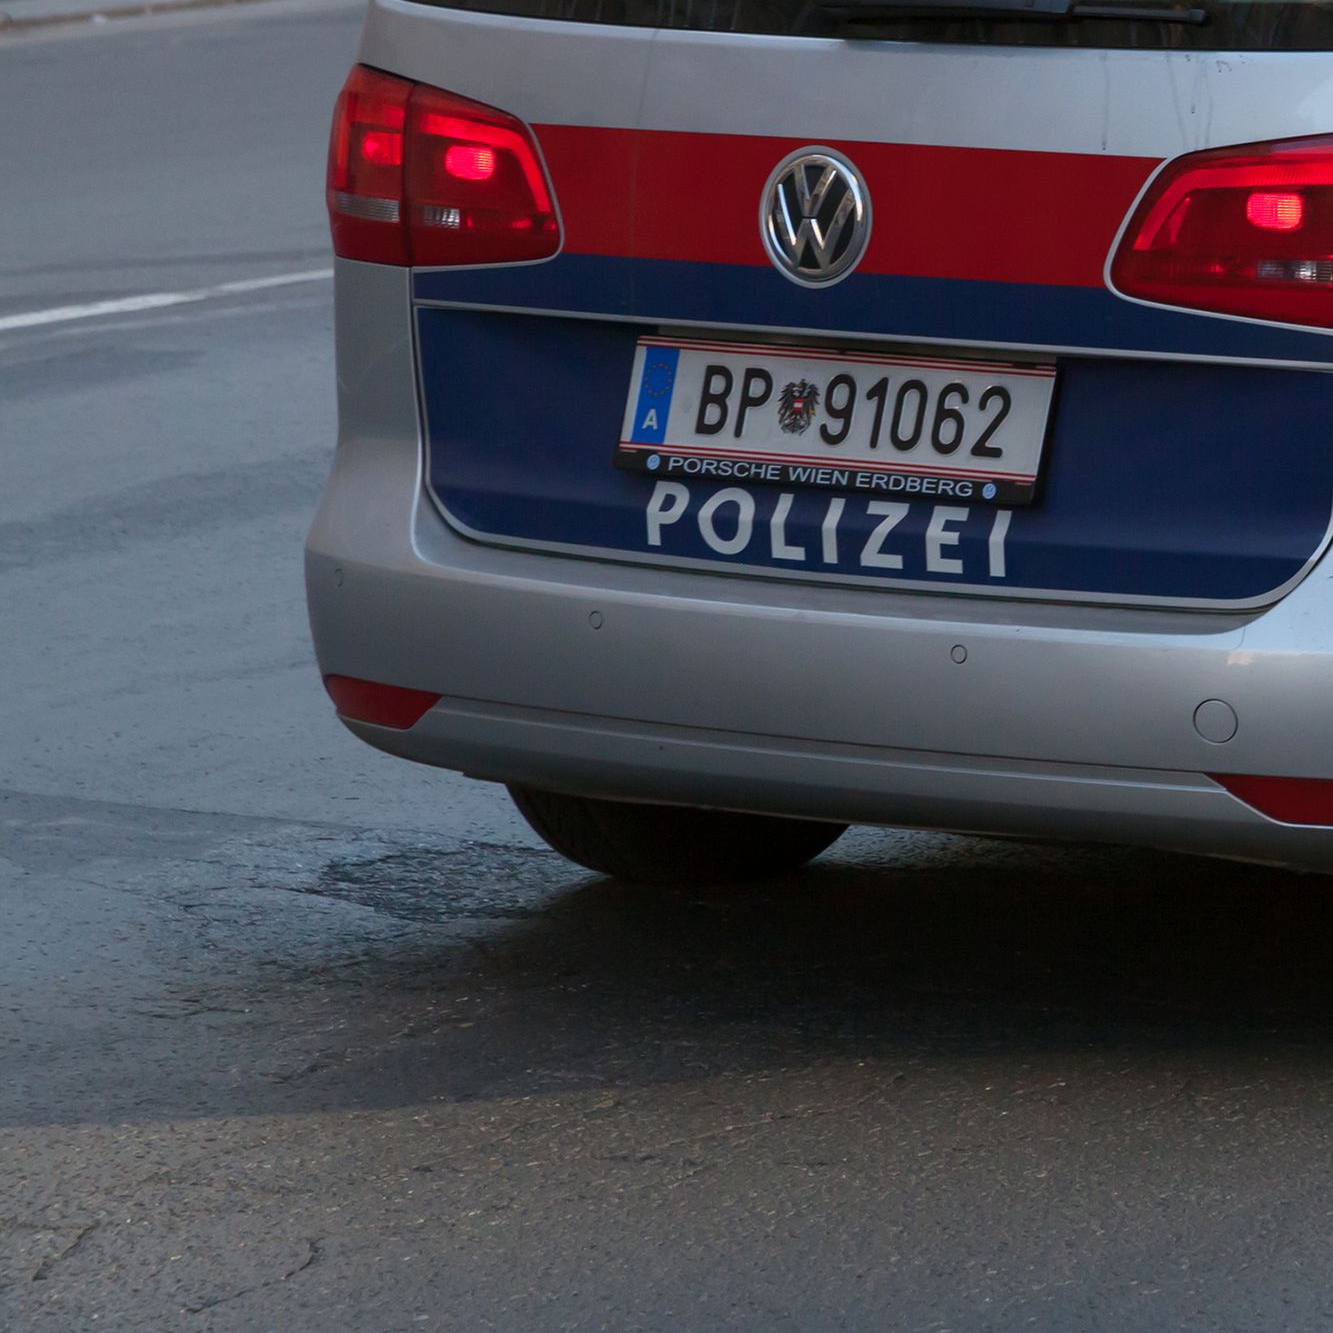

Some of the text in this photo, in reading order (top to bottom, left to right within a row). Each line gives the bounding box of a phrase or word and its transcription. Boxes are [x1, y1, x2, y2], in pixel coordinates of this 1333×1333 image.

[641, 408, 659, 431] A
[694, 364, 1012, 458] BP 91062
[667, 456, 973, 497] PORSCHE WIEN ERDBERG
[646, 480, 1012, 578] POLIZEI
